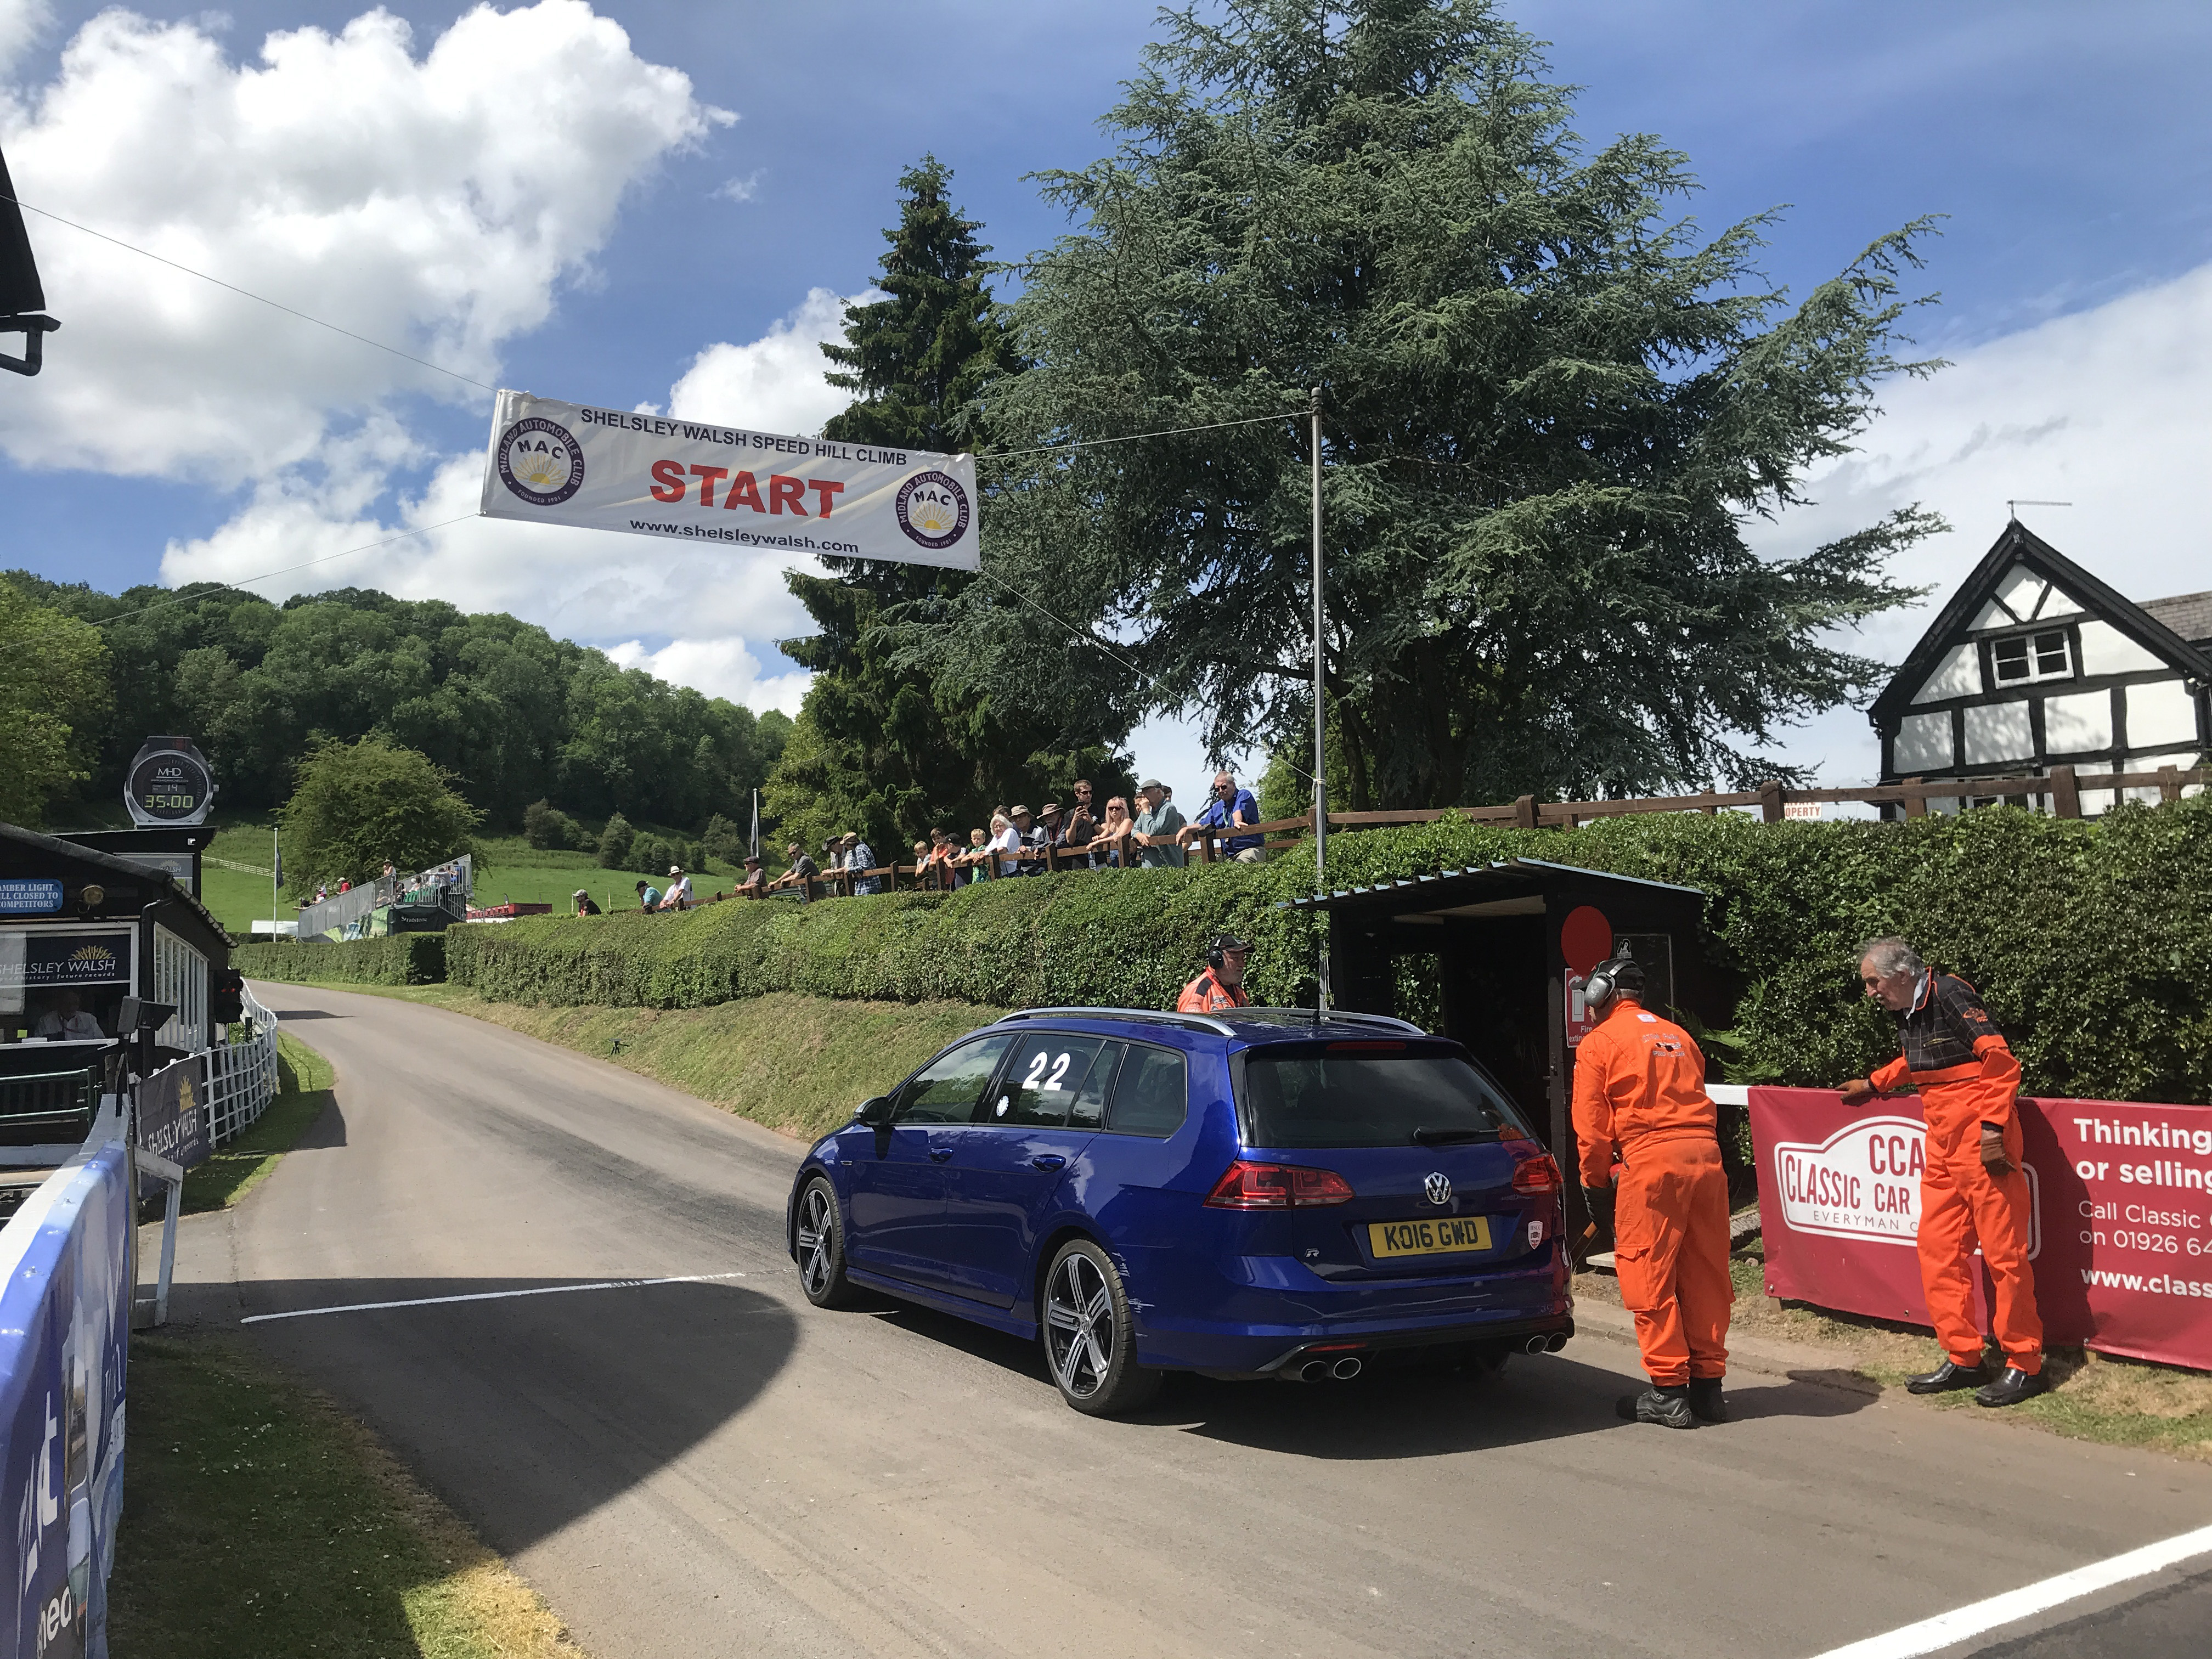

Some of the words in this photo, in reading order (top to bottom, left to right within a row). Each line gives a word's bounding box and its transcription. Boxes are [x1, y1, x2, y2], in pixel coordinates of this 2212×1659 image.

[517, 440, 564, 460] MAC
[581, 409, 678, 436] SHELSLEY
[683, 425, 747, 447] WALSH
[752, 435, 810, 455] SPEED
[815, 443, 851, 460] HILL
[856, 449, 907, 466] CLIMB
[500, 428, 518, 473] MIDLAND
[520, 420, 580, 456] AUTOMOBILE
[570, 459, 583, 486] CLUB
[517, 489, 545, 503] FOUNDED
[650, 460, 844, 519] START
[898, 483, 913, 523] MIDLAND
[915, 473, 964, 501] AUTOMOBILE
[958, 504, 968, 528] CLUB
[913, 490, 951, 506] MAC
[630, 520, 859, 553] www.shelsleywalsh.com
[915, 535, 938, 547] FOUNDED
[941, 538, 952, 546] 1901
[157, 768, 182, 776] MHD
[144, 795, 193, 808] 35.00
[0, 962, 64, 974] HELSLEY
[68, 960, 116, 972] WALSH
[1022, 1052, 1070, 1091] 22
[2073, 1118, 2212, 1155] Thinking
[1869, 1134, 1926, 1177] CCA
[1786, 1154, 1860, 1210] CLASSIC
[1875, 1183, 1910, 1215] CAR
[2076, 1160, 2109, 1181] or
[1814, 1210, 1899, 1230] EVERYMAN
[2079, 1200, 2117, 1220] Call
[2125, 1204, 2201, 1229] Classic
[1384, 1223, 1434, 1250] KO16
[1438, 1221, 1479, 1246] GWD
[2080, 1231, 2106, 1246] on
[2114, 1229, 2178, 1254] 01926
